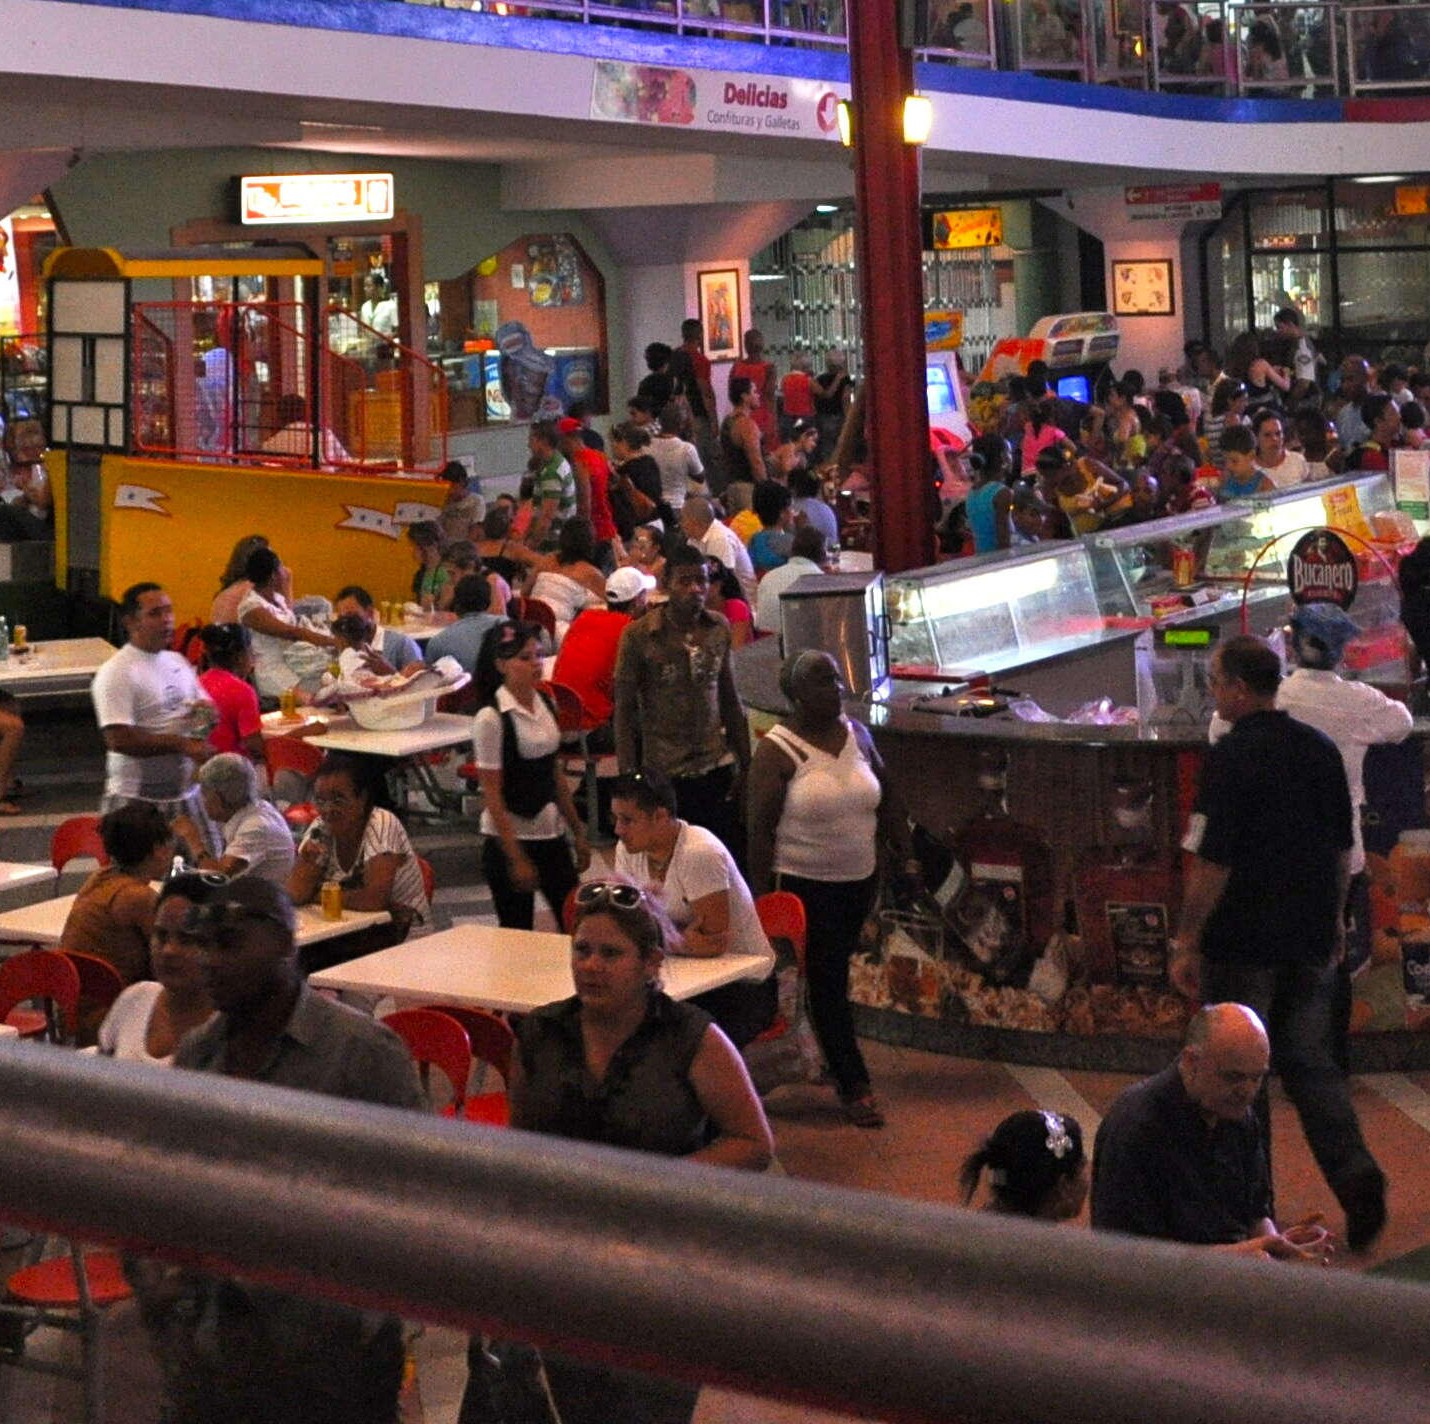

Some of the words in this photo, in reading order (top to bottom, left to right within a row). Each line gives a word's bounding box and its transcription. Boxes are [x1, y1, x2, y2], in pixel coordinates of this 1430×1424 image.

[723, 82, 788, 109] Delicias
[707, 109, 756, 126] Confituras
[764, 114, 800, 130] Galletas
[1293, 554, 1353, 592] Bucanero
